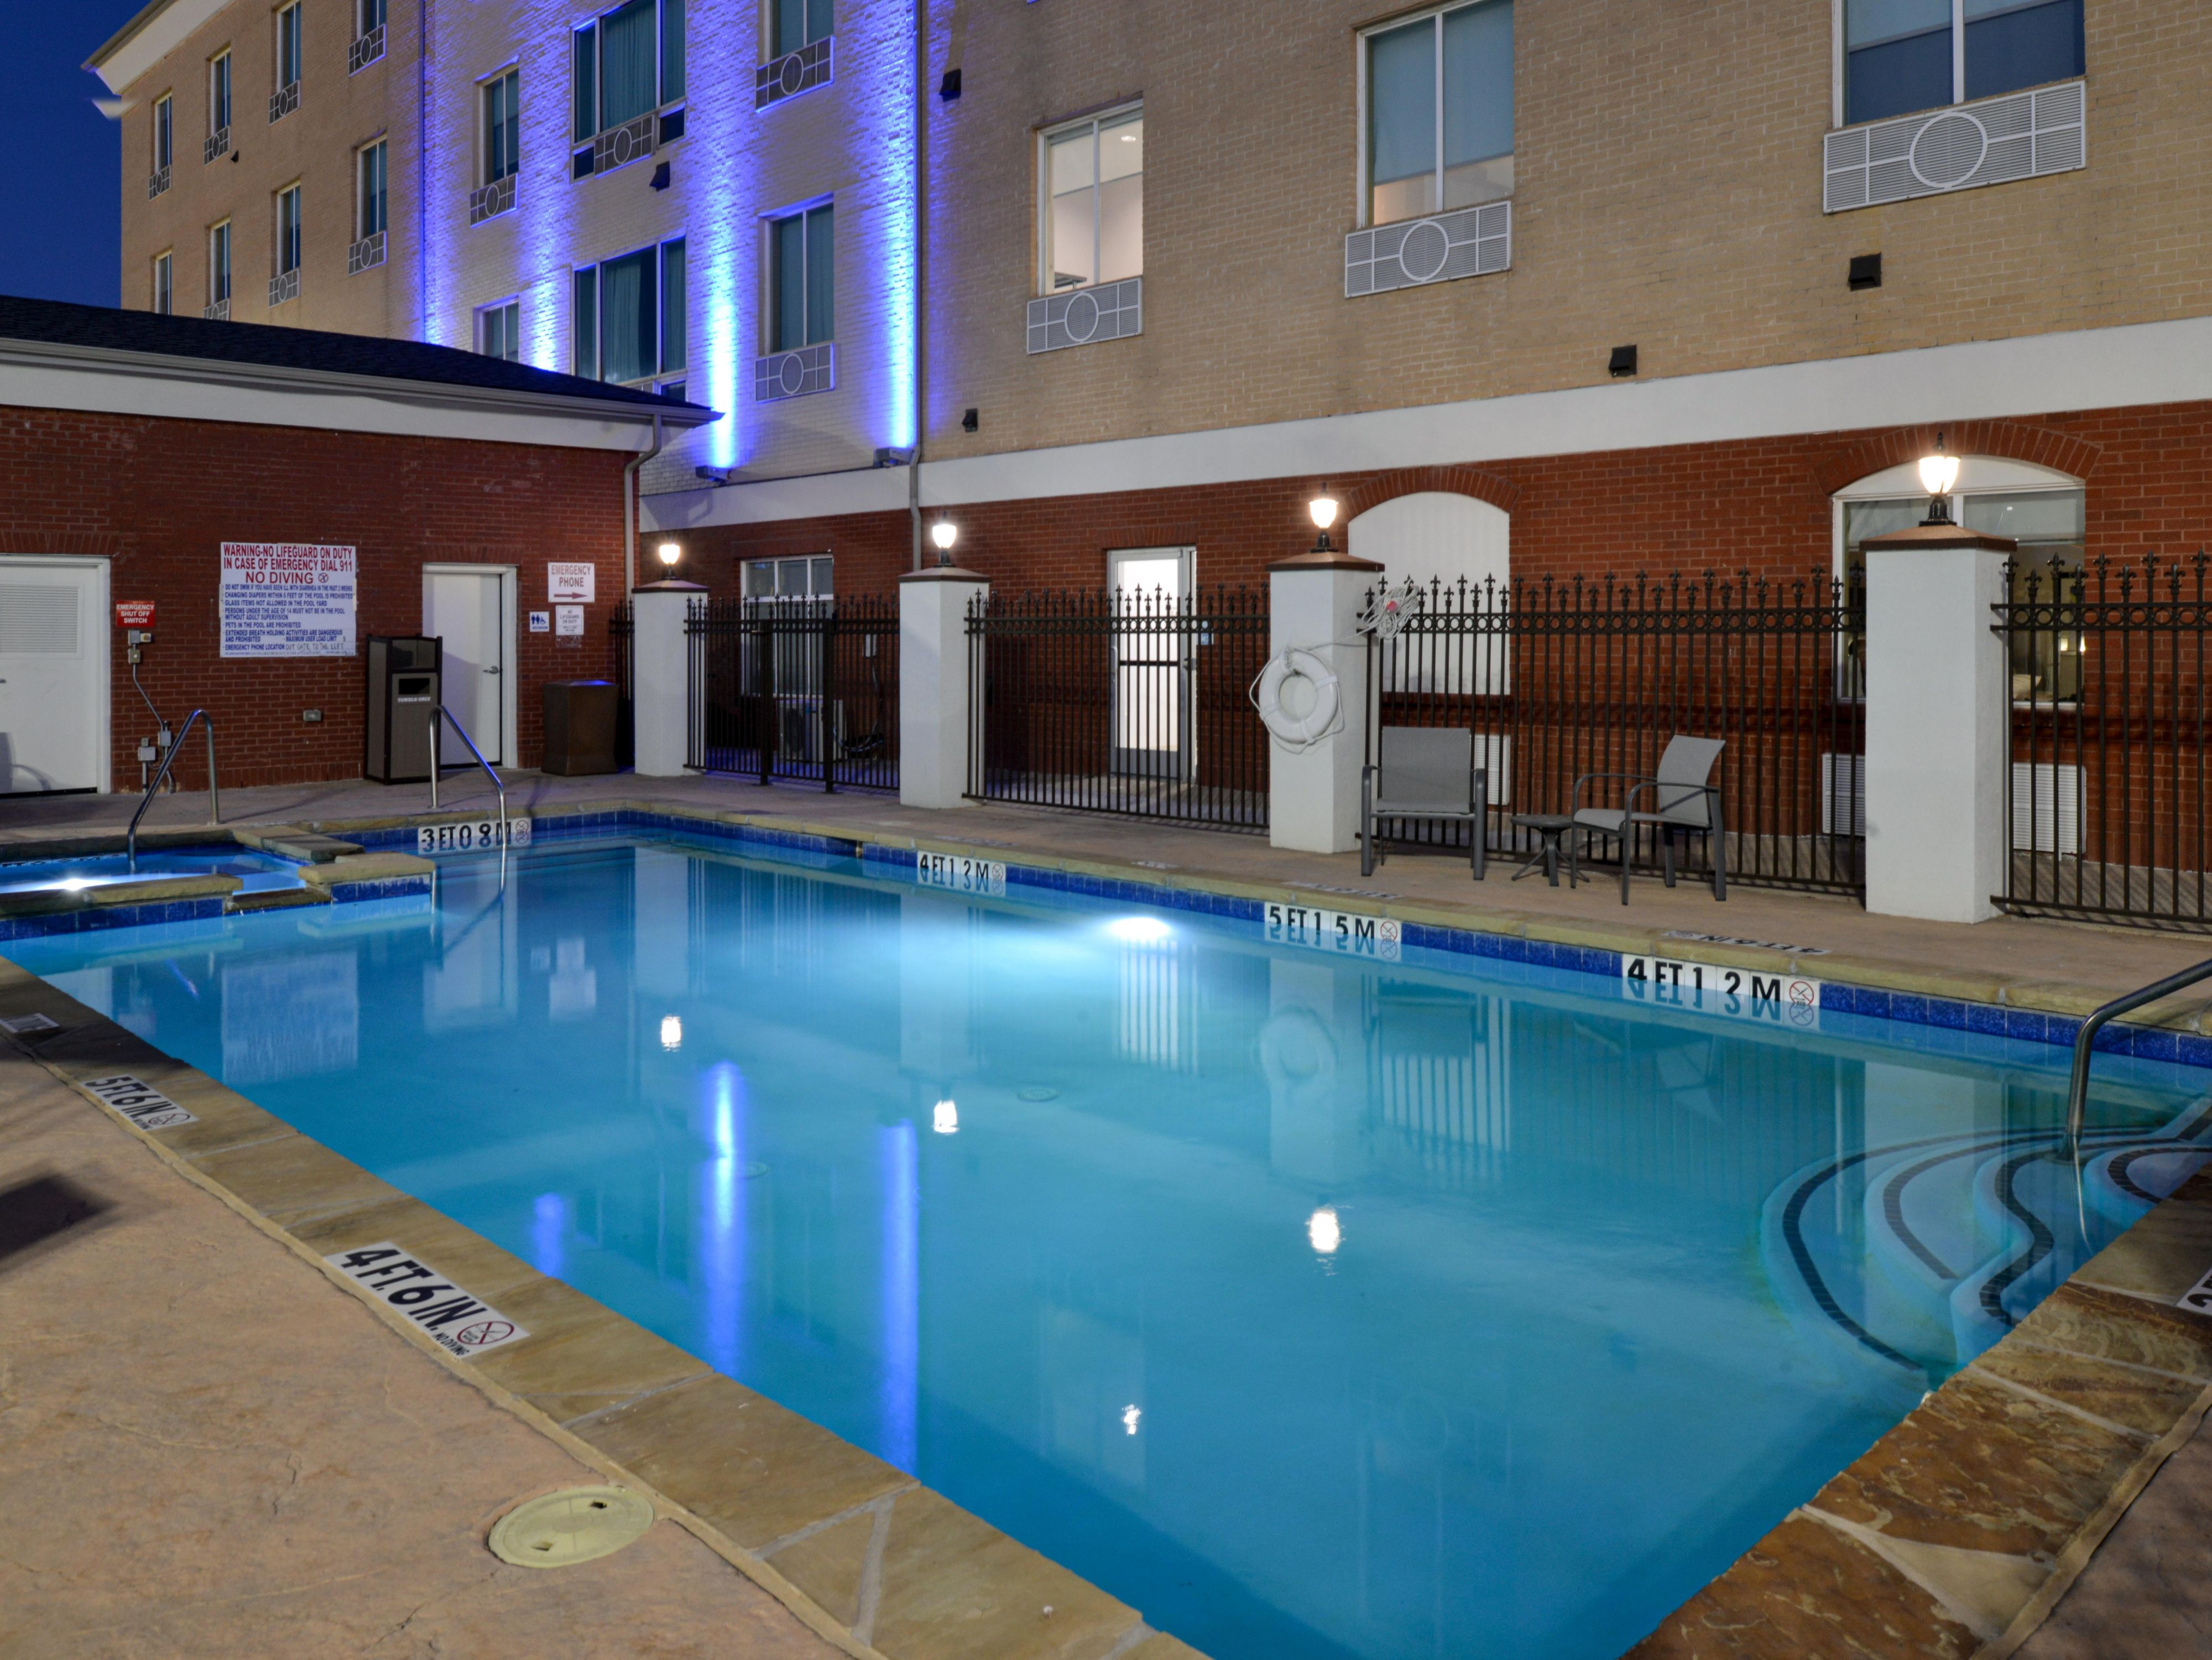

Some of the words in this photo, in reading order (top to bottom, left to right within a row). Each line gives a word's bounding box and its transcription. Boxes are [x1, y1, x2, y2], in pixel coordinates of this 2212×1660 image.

[223, 544, 274, 557] WARNING-NO
[276, 545, 317, 558] LIFEGUARD
[321, 547, 330, 559] ON
[333, 548, 352, 559] DUTY
[224, 557, 232, 569] IN
[235, 558, 255, 569] CASE
[258, 558, 268, 570] OF
[271, 559, 318, 571] EMERGENCY
[321, 560, 338, 571] DIAL
[340, 560, 352, 571] 911
[551, 565, 591, 575] EMERGENCY
[246, 571, 265, 583] NO
[270, 572, 313, 584] DIVING
[559, 577, 584, 587] PHONE
[85, 1076, 133, 1087] 5
[111, 1095, 161, 1105] 6
[341, 1249, 401, 1268] 4
[355, 1260, 434, 1291] FT.
[388, 1284, 455, 1304] 6
[408, 1295, 487, 1331] IN.
[434, 1333, 450, 1341] NO
[440, 1339, 470, 1356] DIVING
